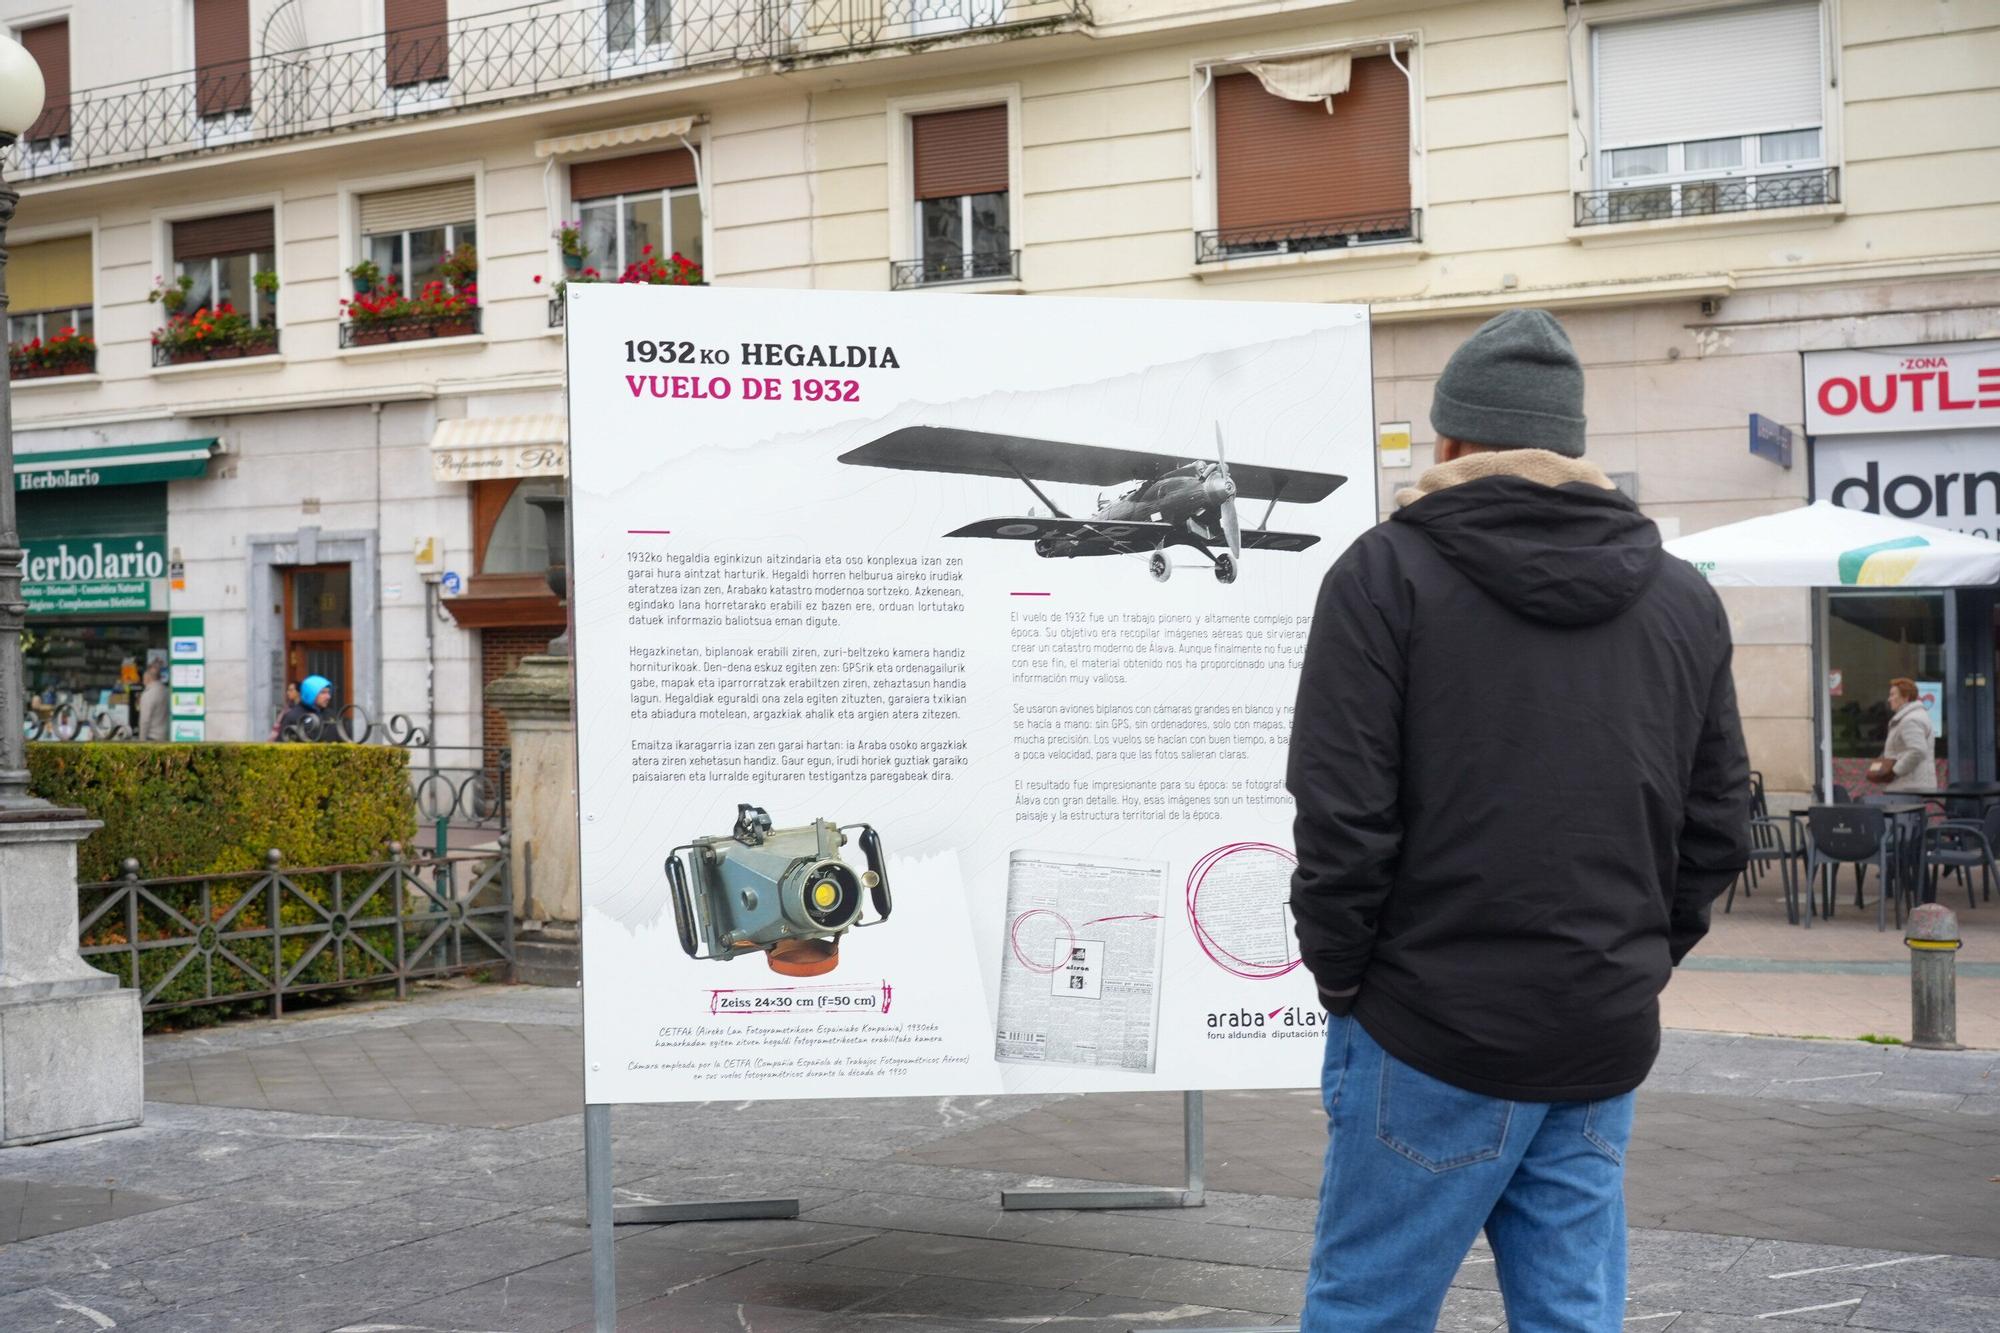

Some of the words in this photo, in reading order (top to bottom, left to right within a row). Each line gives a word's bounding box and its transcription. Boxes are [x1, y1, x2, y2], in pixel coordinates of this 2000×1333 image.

[741, 343, 900, 368] HEGALDIA
[1905, 357, 1948, 369] ZONA
[625, 374, 731, 399] VUELO
[741, 377, 781, 400] DE
[791, 378, 859, 402] 1932
[1817, 368, 2000, 416] OUTLE
[20, 469, 100, 490] Herbolario
[627, 552, 662, 562] 1932ko
[666, 552, 709, 565] hegaldia
[713, 553, 762, 565] eginkizun
[766, 553, 821, 564] aitzindaria
[825, 554, 841, 564] eta
[845, 556, 863, 565] oso
[867, 554, 917, 567] konplexua
[921, 555, 941, 565] izan
[945, 557, 963, 566] zen
[627, 567, 653, 580] garai
[657, 568, 680, 578] hura
[684, 568, 720, 579] aintzat
[724, 568, 768, 579] harturik.
[772, 569, 808, 581] Hegaldi
[812, 569, 845, 580] horren
[849, 569, 893, 580] helburua
[896, 570, 926, 580] aireko
[929, 570, 963, 581] irudiak
[628, 583, 677, 594] ateratzea
[680, 584, 701, 594] izan
[703, 586, 723, 595] zen,
[726, 584, 767, 594] Arabako
[769, 584, 812, 595] katastro
[814, 585, 864, 595] modernoa
[866, 585, 912, 596] sortzeko.
[914, 586, 963, 597] Azkenean,
[627, 599, 674, 611] egindako
[678, 599, 700, 610] lana
[704, 599, 766, 610] horretarako
[770, 600, 801, 610] erabili
[805, 602, 817, 610] ez
[821, 600, 851, 611] bazen
[855, 603, 875, 612] ere,
[878, 600, 914, 611] orduan
[918, 601, 964, 611] lortutako
[628, 614, 663, 625] datuek
[667, 614, 722, 625] informazio
[725, 615, 772, 626] baliotsua
[774, 617, 802, 626] eman
[805, 615, 840, 628] digute.
[1012, 672, 1067, 683] información
[1069, 675, 1089, 685] muy
[1092, 672, 1127, 683] valiosa.
[631, 739, 672, 750] Emaitza
[675, 739, 731, 752] ikaragarria
[734, 739, 755, 750] izan
[758, 742, 775, 750] zen
[777, 739, 803, 752] garai
[806, 739, 843, 750] hartan:
[846, 739, 855, 750] ia
[857, 739, 886, 750] Araba
[889, 739, 917, 750] osoko
[920, 739, 967, 752] argazkiak
[631, 755, 659, 765] atera
[661, 755, 686, 765] ziren
[689, 755, 741, 765] xehetasun
[743, 755, 778, 765] handiz.
[781, 755, 805, 765] Gaur
[806, 757, 834, 767] egun,
[836, 755, 858, 765] irudi
[861, 755, 891, 765] horiek
[894, 755, 930, 767] guztiak
[932, 755, 968, 767] garaiko
[1014, 751, 1020, 759] a
[1022, 751, 1045, 761] poca
[1048, 749, 1093, 761] velocidad,
[1096, 751, 1117, 761] para
[1119, 751, 1136, 761] que
[1139, 749, 1152, 759] las
[1154, 749, 1178, 759] fotos
[1181, 749, 1216, 759] salieran
[1219, 749, 1248, 759] claras.
[632, 771, 685, 783] paisaiaren
[689, 771, 705, 781] eta
[709, 770, 749, 781] lurralde
[752, 770, 805, 783] egituraren
[808, 770, 867, 783] testigantza
[870, 770, 928, 783] paregabeak
[931, 770, 953, 781] dira.
[1014, 779, 1023, 790] El
[1026, 779, 1070, 790] resultado
[1073, 779, 1088, 790] fue
[1092, 779, 1157, 791] impresionante
[1159, 781, 1181, 791] para
[1184, 781, 1195, 789] su
[1231, 781, 1242, 789] se
[1042, 797, 1060, 805] con
[1062, 797, 1083, 807] gran
[1086, 794, 1119, 805] detalle.
[1121, 794, 1141, 807] Hoy,
[1143, 796, 1165, 805] esas
[1213, 796, 1229, 804] son
[1231, 796, 1243, 804] un
[1245, 794, 1294, 804] testimonio
[1015, 810, 1048, 822] paisaje
[1050, 812, 1056, 822] y
[1059, 810, 1068, 820] la
[1070, 810, 1119, 820] estructura
[1122, 810, 1165, 820] territorial
[1168, 810, 1179, 820] de
[1182, 810, 1190, 820] la
[721, 997, 751, 1007] Zeiss
[796, 998, 813, 1006] cm
[817, 995, 850, 1008] (f=50
[854, 994, 875, 1007] cm)
[1207, 1008, 1265, 1027] araba
[1284, 1007, 1328, 1026] álav
[1207, 1031, 1225, 1039] foru
[1227, 1030, 1266, 1039] aldundia
[1271, 1029, 1318, 1039] diputación
